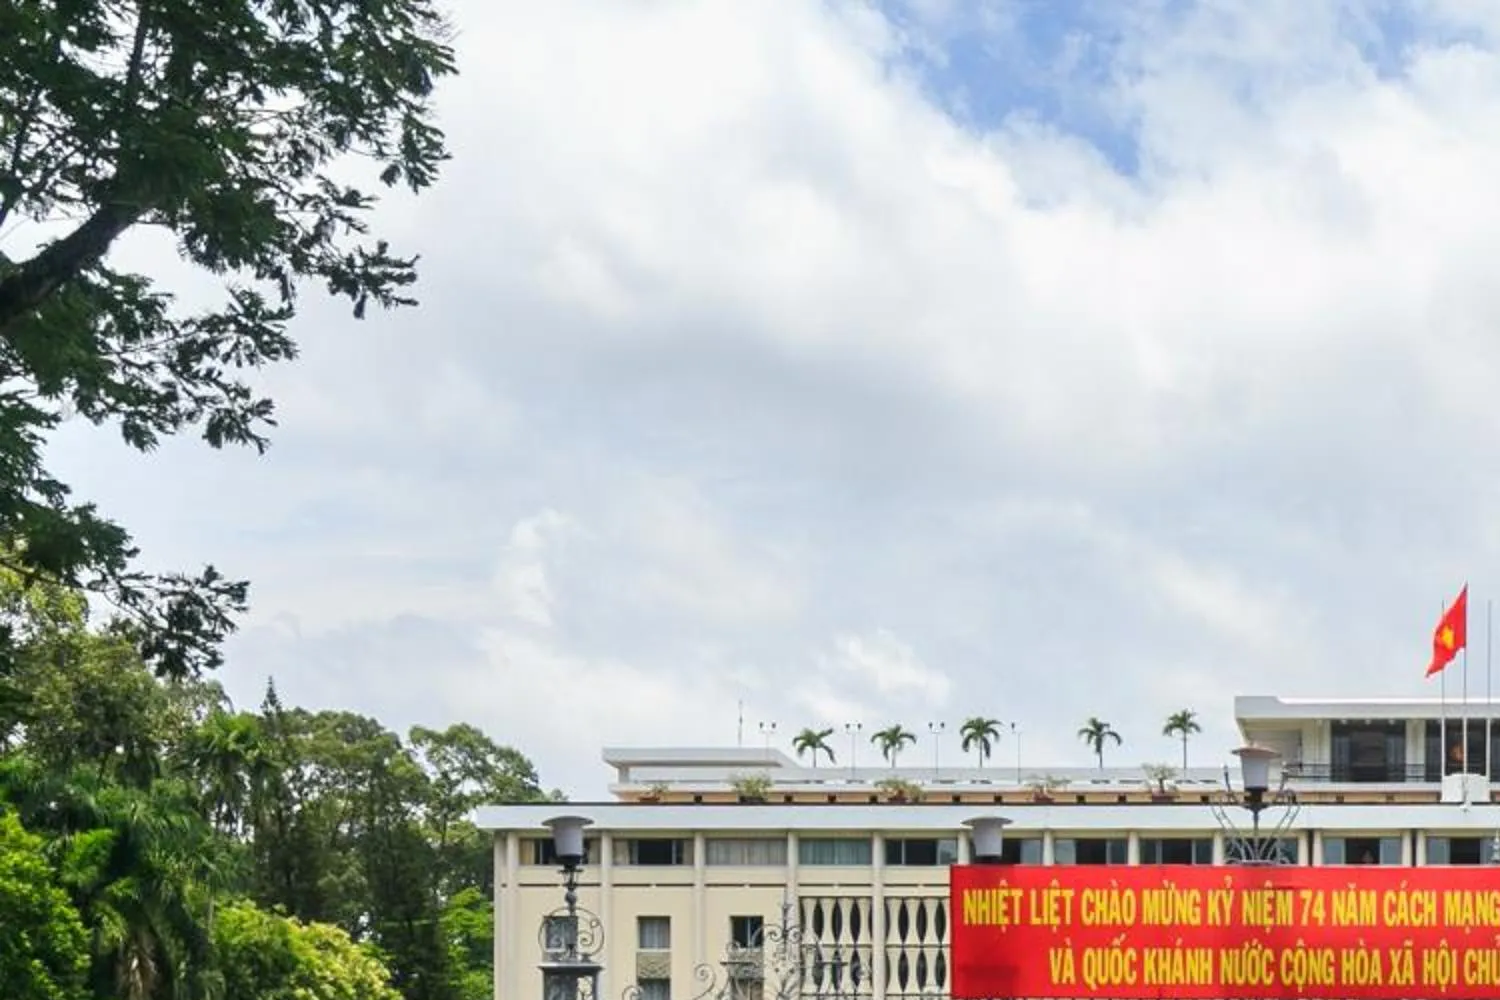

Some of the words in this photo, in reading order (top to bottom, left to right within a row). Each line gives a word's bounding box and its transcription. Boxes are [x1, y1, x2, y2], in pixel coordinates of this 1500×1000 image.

[963, 879, 1023, 933] NHIỆT
[1030, 879, 1074, 933] LIỆT
[1081, 879, 1136, 926] CHÀO
[1142, 879, 1202, 926] MỪNG
[1208, 874, 1234, 926] KỶ
[1242, 880, 1293, 933] NIỆM
[1300, 889, 1326, 926] 74
[1332, 882, 1377, 926] NĂM
[1384, 880, 1437, 926] CÁCH
[1049, 937, 1075, 985] VÀ
[1082, 934, 1137, 990] QUỐC
[1143, 937, 1213, 985] KHÁNH
[1220, 938, 1274, 985] NƯỚC
[1280, 938, 1335, 992] CỘNG
[1342, 938, 1382, 985] HÒA
[1389, 940, 1415, 985] XÃ
[1423, 938, 1456, 992] HỘI
